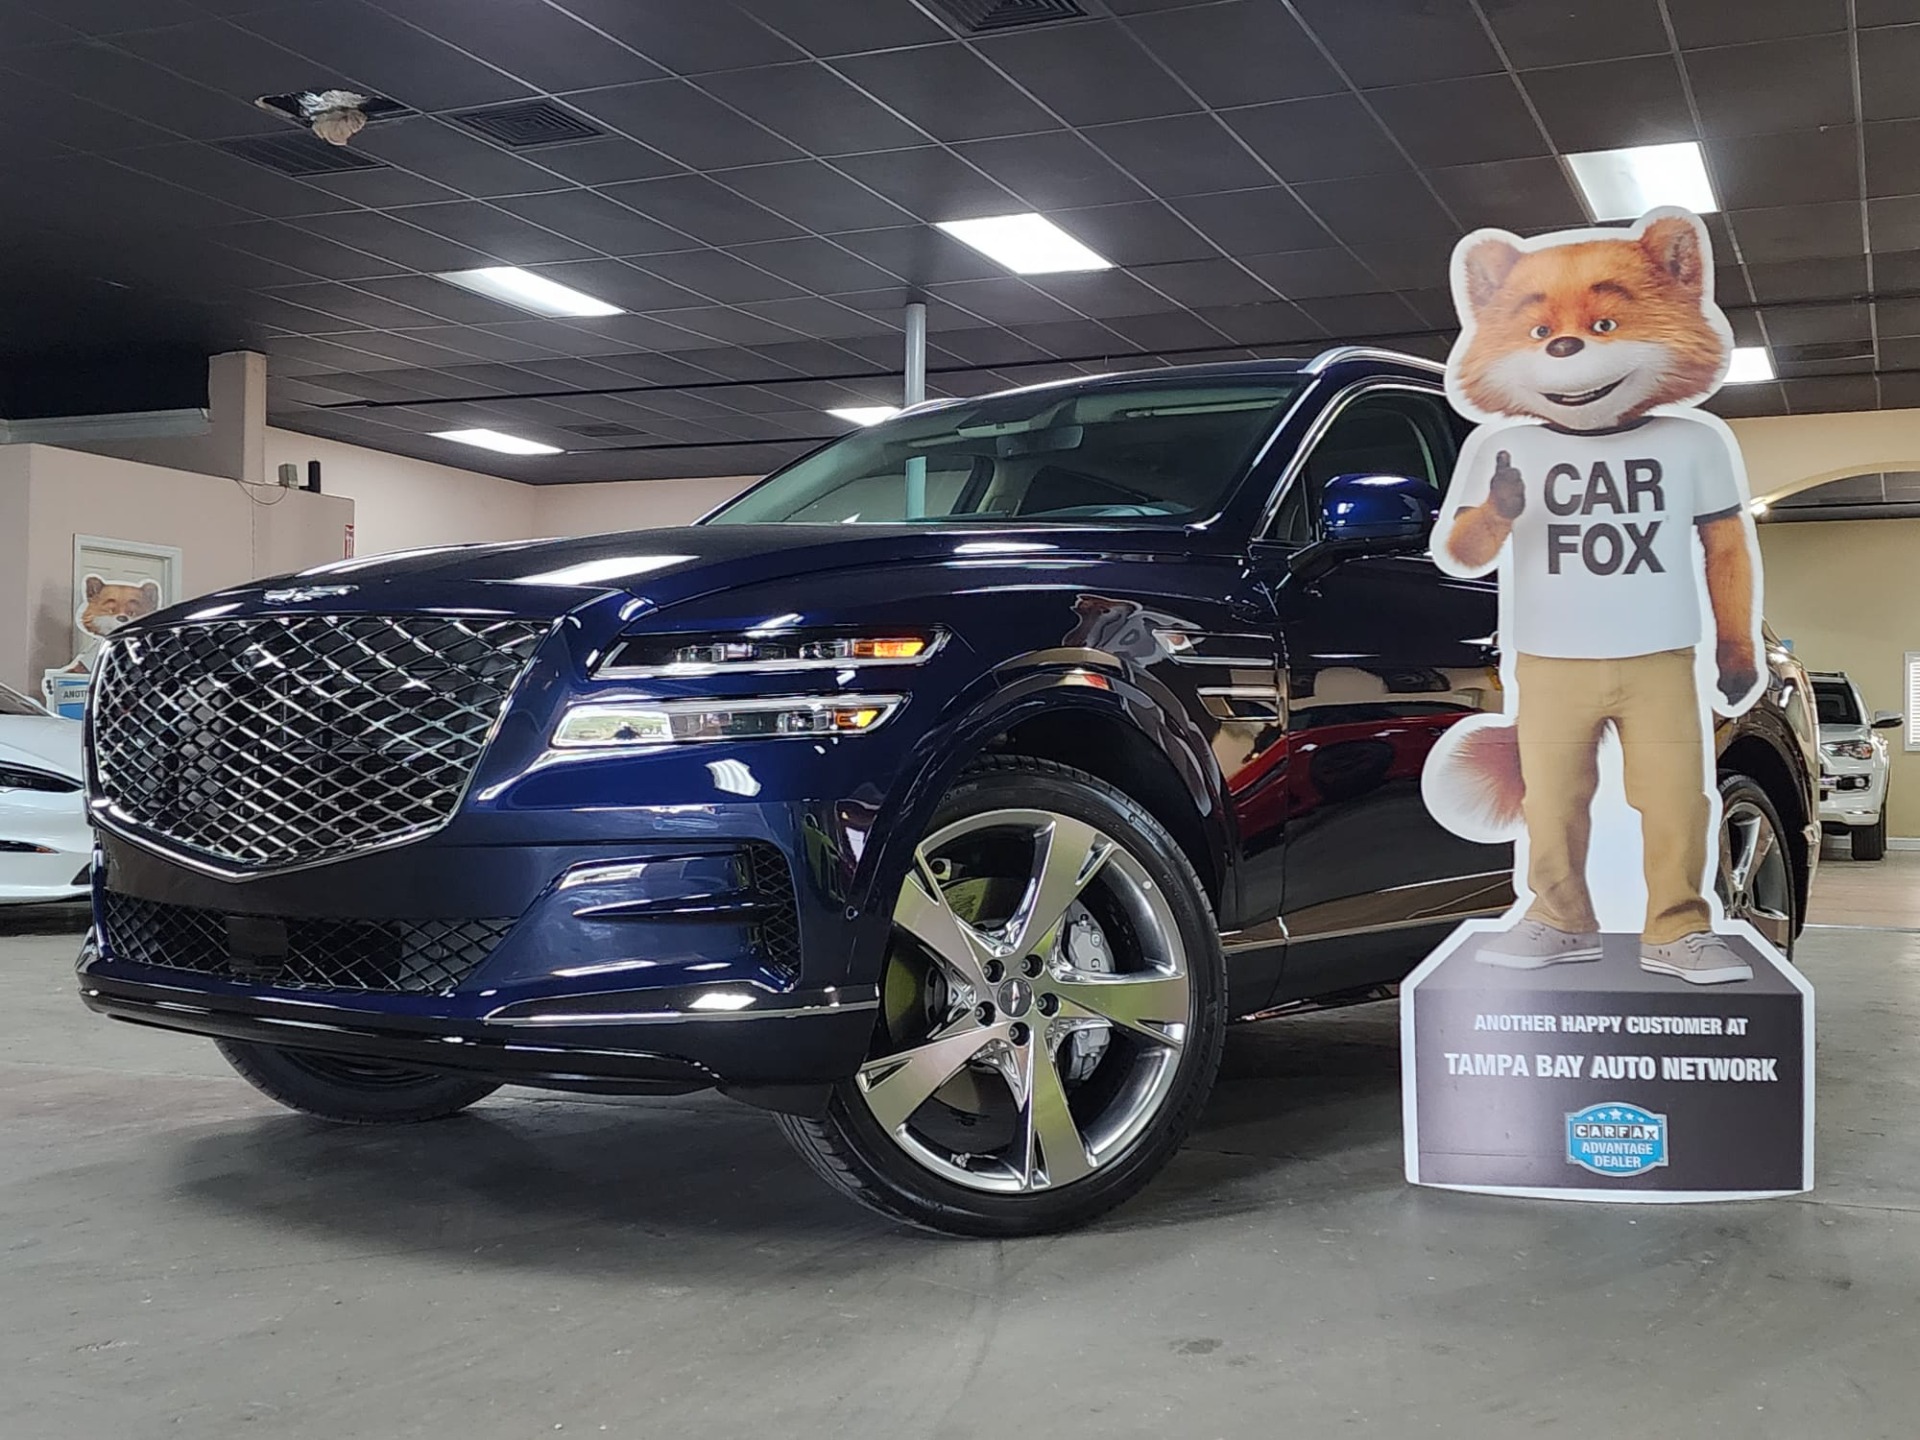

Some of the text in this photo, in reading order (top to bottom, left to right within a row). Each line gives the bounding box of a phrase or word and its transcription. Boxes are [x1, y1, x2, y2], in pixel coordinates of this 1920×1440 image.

[1544, 458, 1665, 516] CAR
[1547, 521, 1666, 576] FOX
[63, 690, 88, 699] ANOT
[1474, 1014, 1748, 1035] ANOTHER HAPPY CUSTOMER AT
[1443, 1053, 1778, 1082] TAMPA BAY AUTO NETWORK
[1575, 1125, 1658, 1140] CARFAX
[1581, 1142, 1654, 1155] ADVANTAGE
[1594, 1155, 1642, 1168] DEALER
